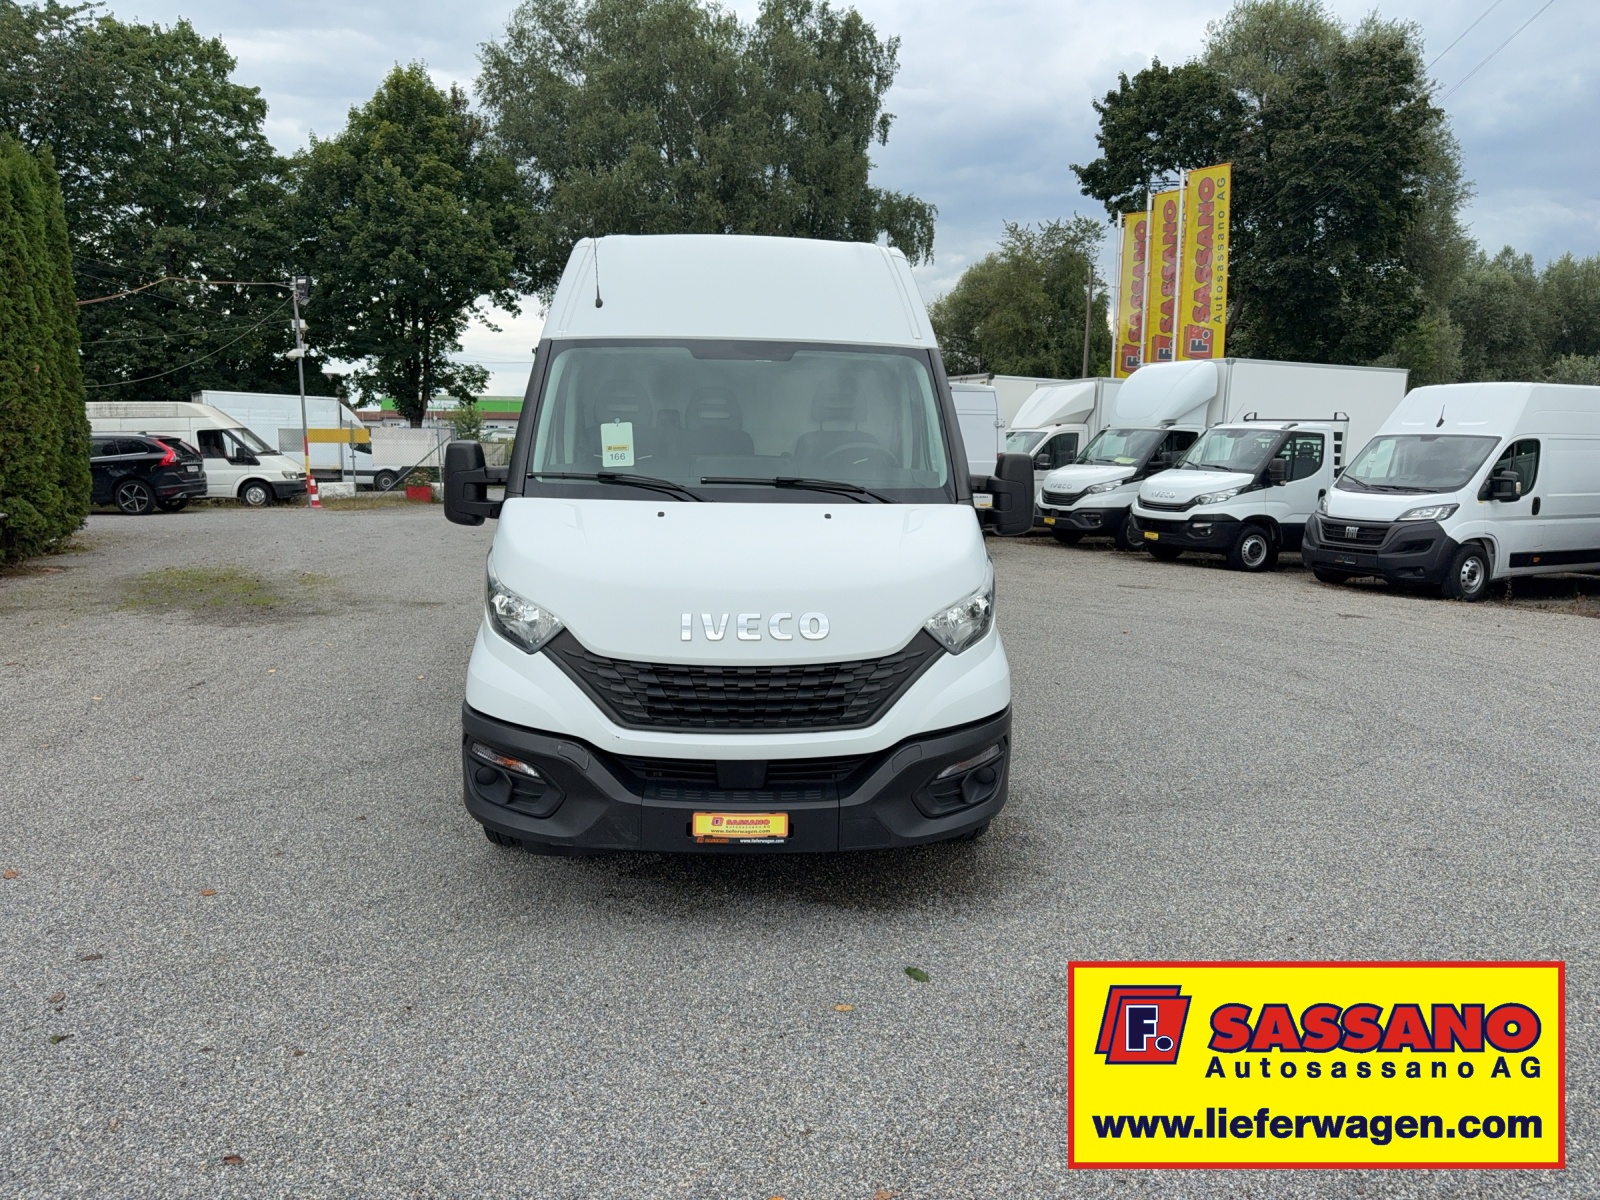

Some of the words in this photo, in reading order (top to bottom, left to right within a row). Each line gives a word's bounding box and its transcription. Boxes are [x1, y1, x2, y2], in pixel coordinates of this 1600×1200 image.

[1216, 177, 1226, 201] AG
[1193, 176, 1215, 324] SASSANO
[1213, 210, 1225, 324] Autosassano
[609, 452, 626, 461] 166
[1151, 491, 1176, 499] IVECO
[680, 611, 831, 642] IVECO
